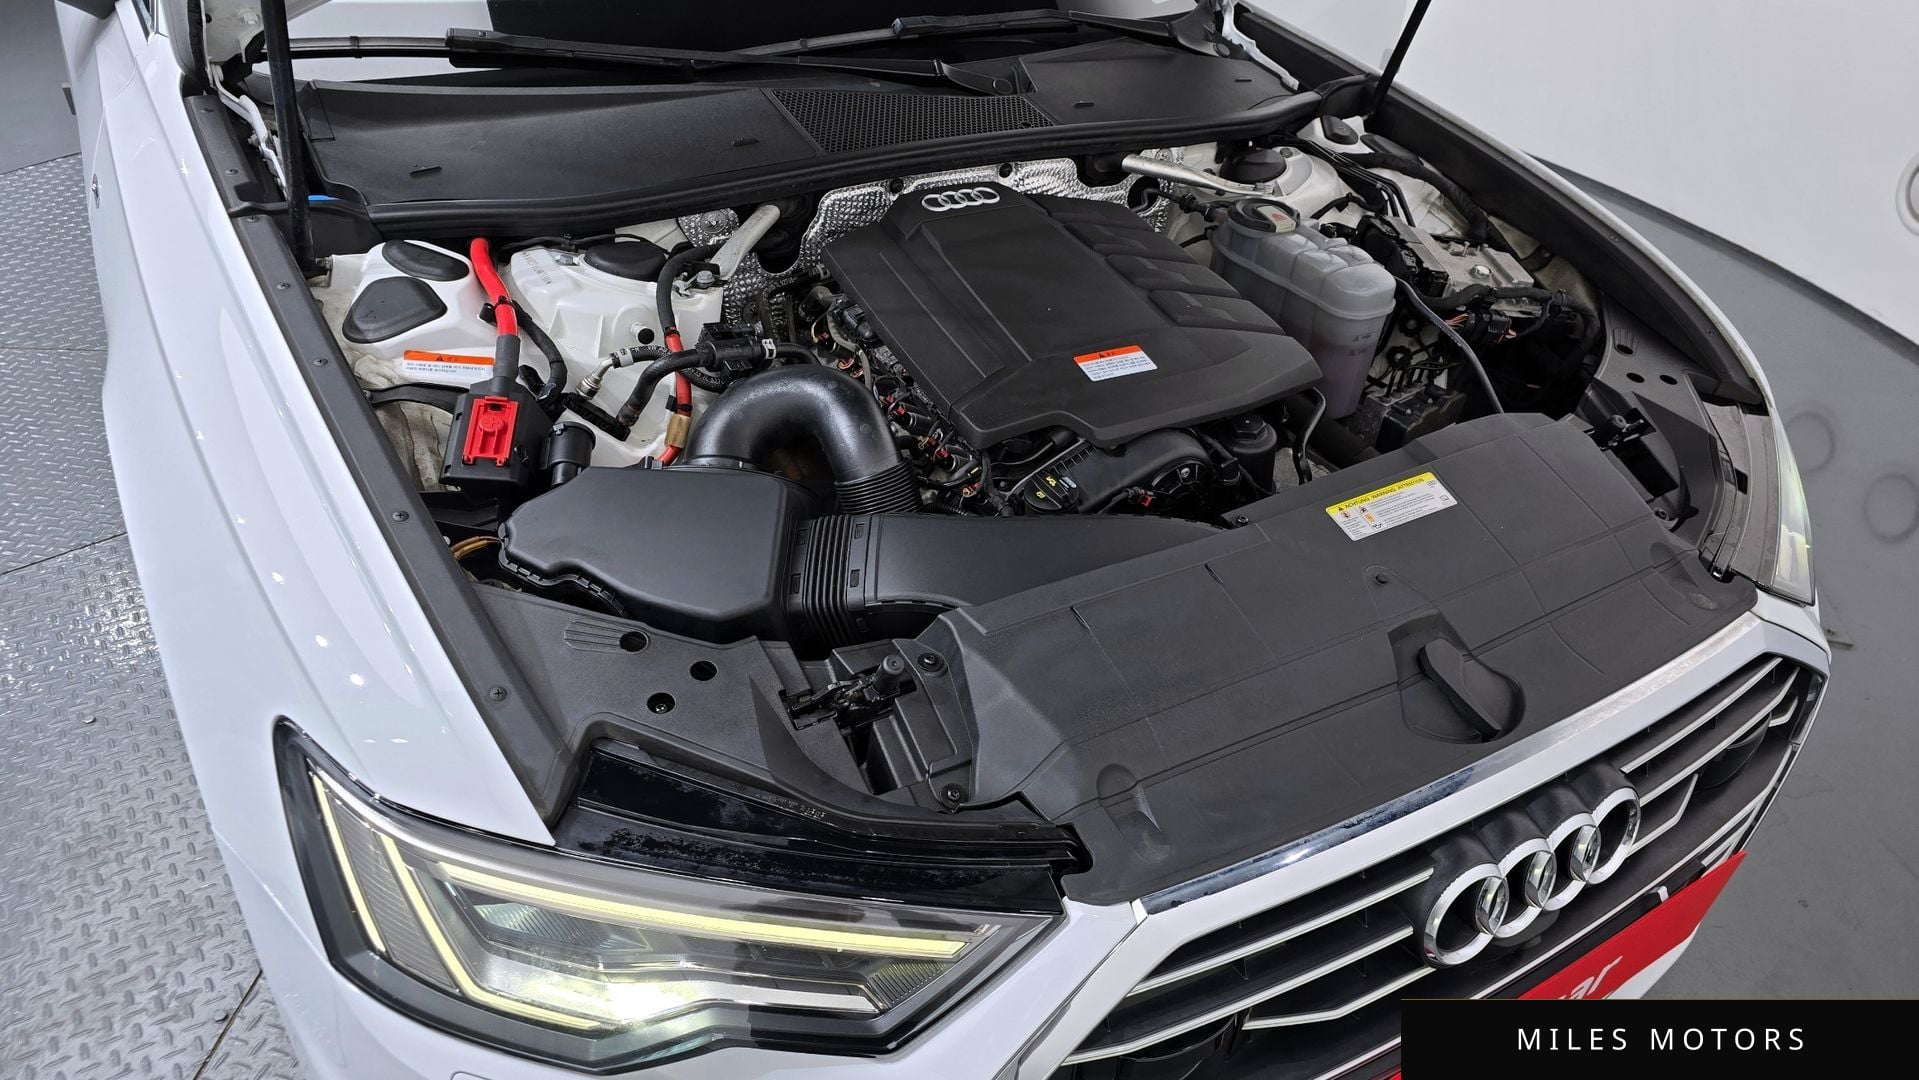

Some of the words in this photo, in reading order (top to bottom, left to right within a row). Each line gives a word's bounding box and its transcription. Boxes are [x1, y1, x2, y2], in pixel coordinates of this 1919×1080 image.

[1345, 497, 1370, 509] ACHTUNG
[1372, 488, 1396, 499] WARNING
[1397, 477, 1424, 490] ATTENTION
[1558, 955, 1623, 999] ar
